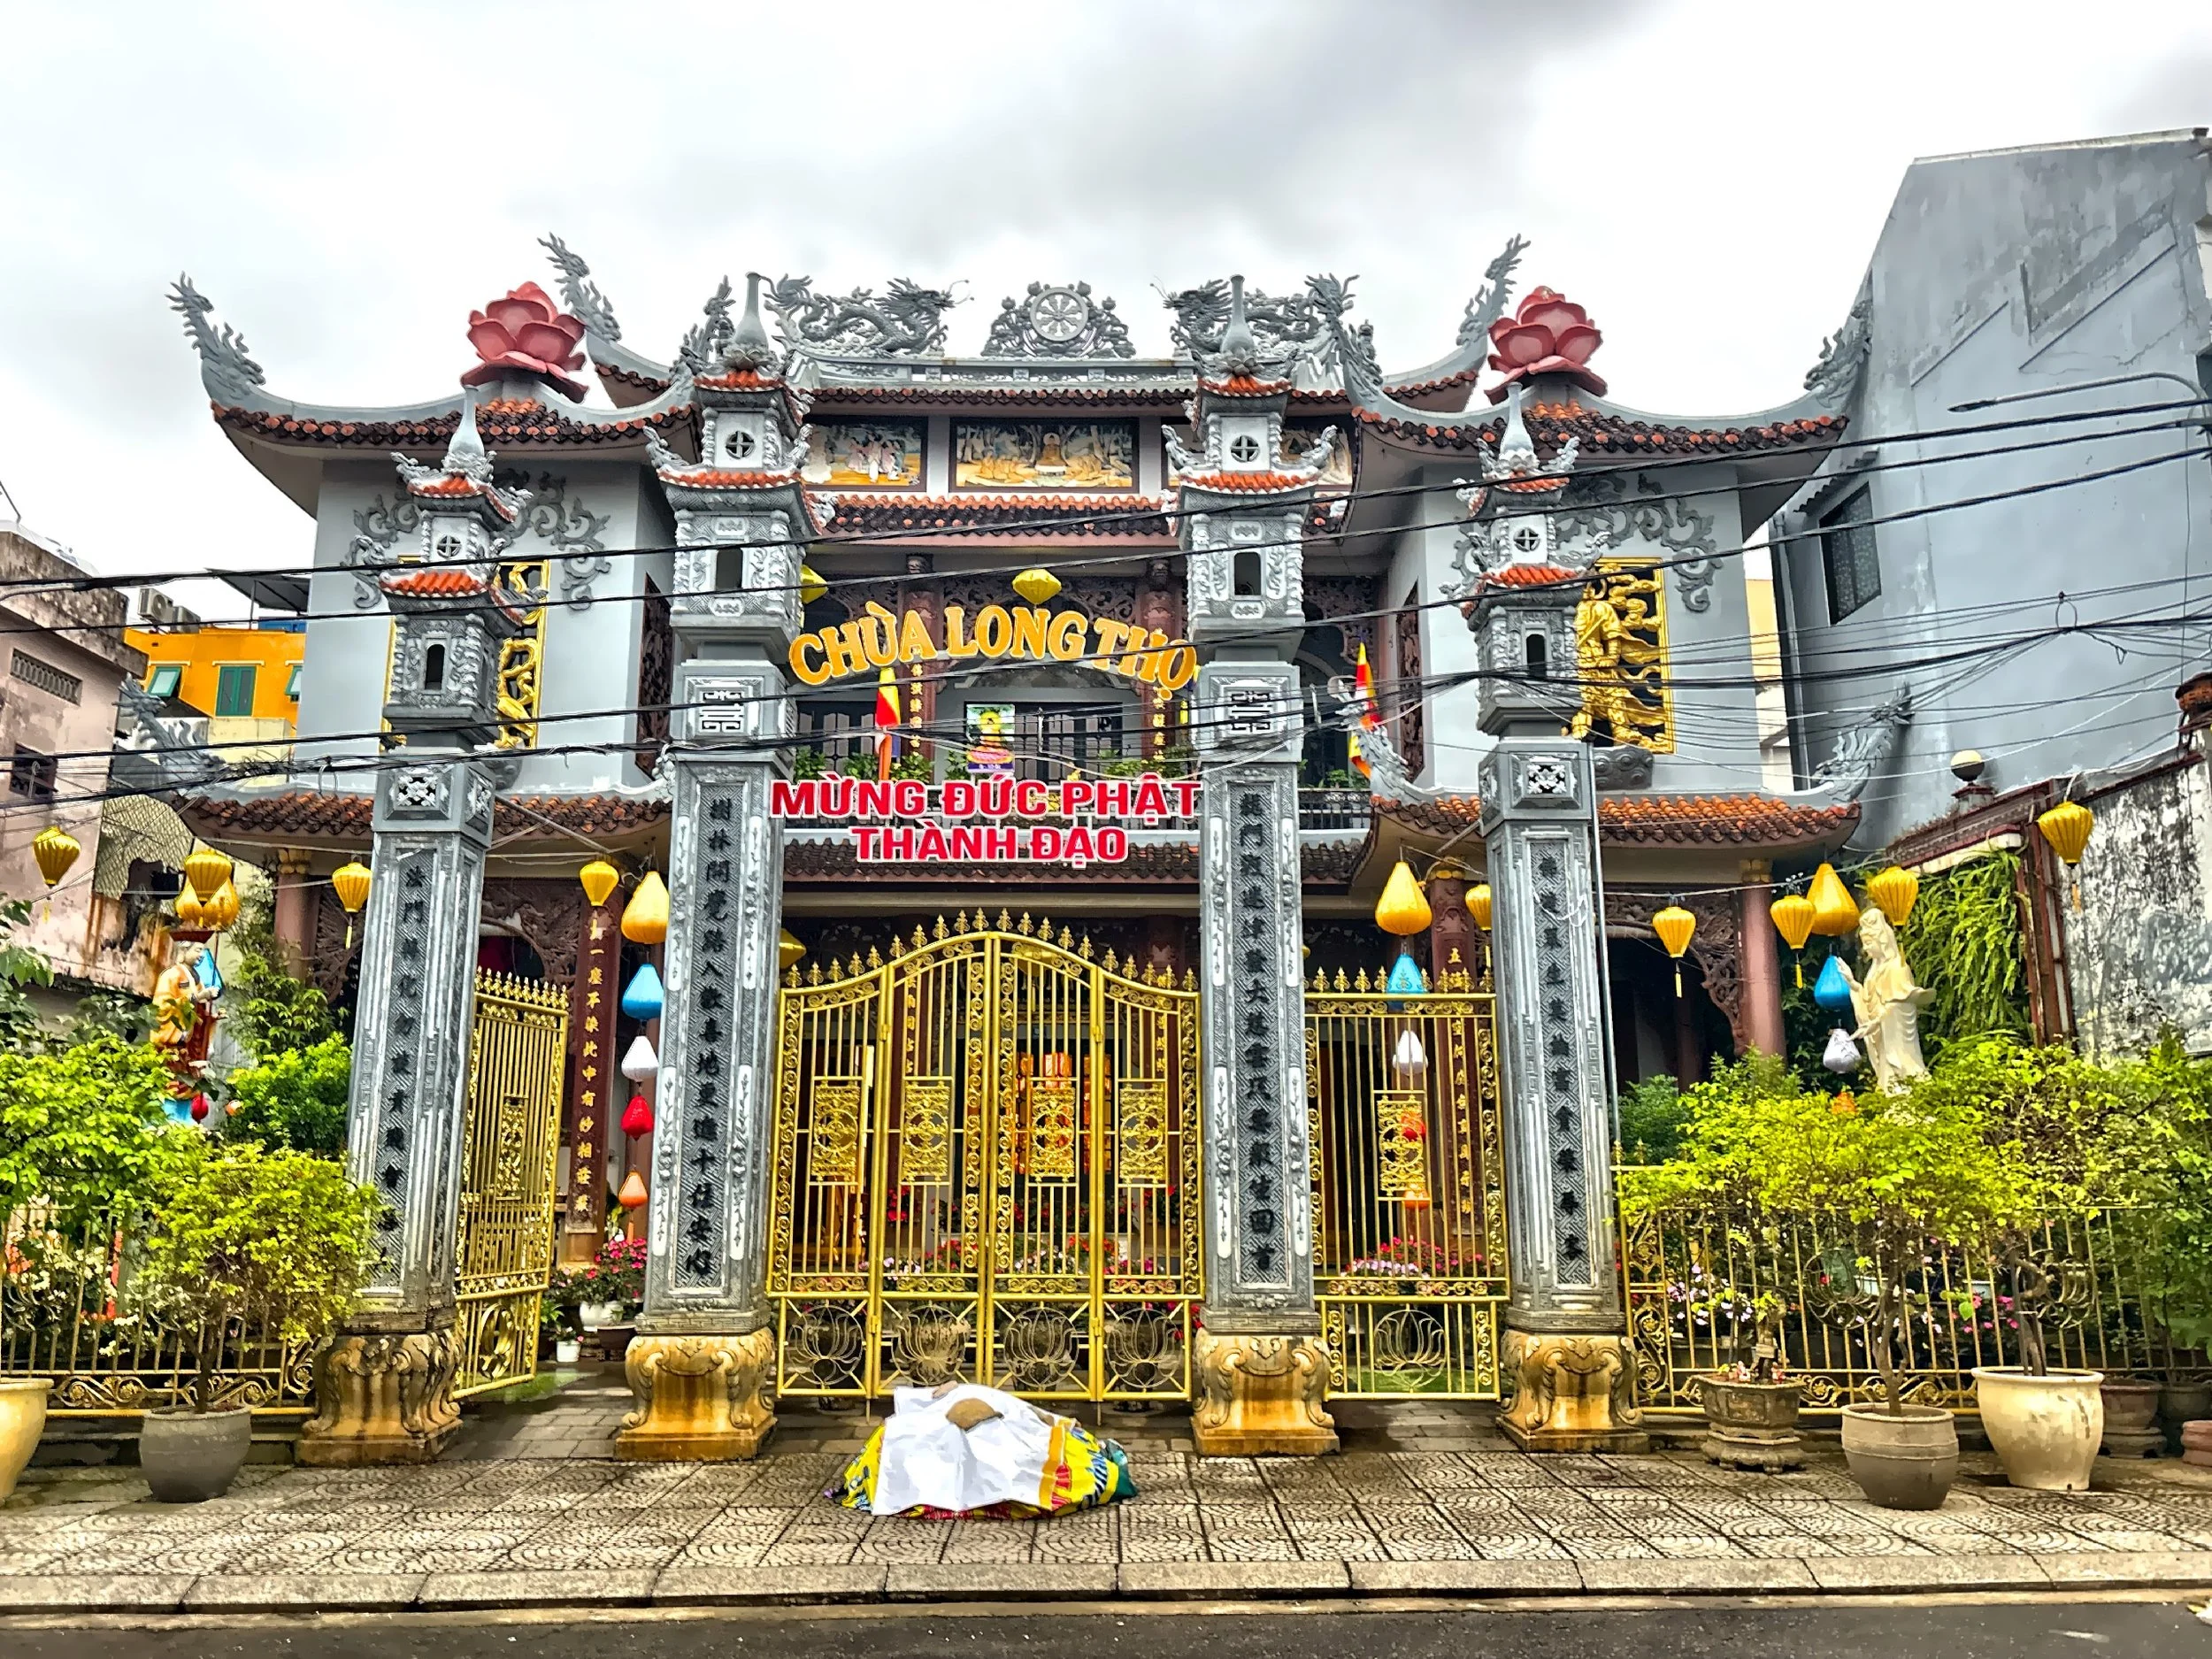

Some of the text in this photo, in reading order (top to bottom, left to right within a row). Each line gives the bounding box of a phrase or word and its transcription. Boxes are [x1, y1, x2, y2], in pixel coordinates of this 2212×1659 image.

[788, 601, 1197, 702] CHÙA LONG THỌ
[770, 771, 1204, 827] MỪNG ĐỨC PHẬT
[851, 818, 1128, 869] THÀNH ĐẠO
